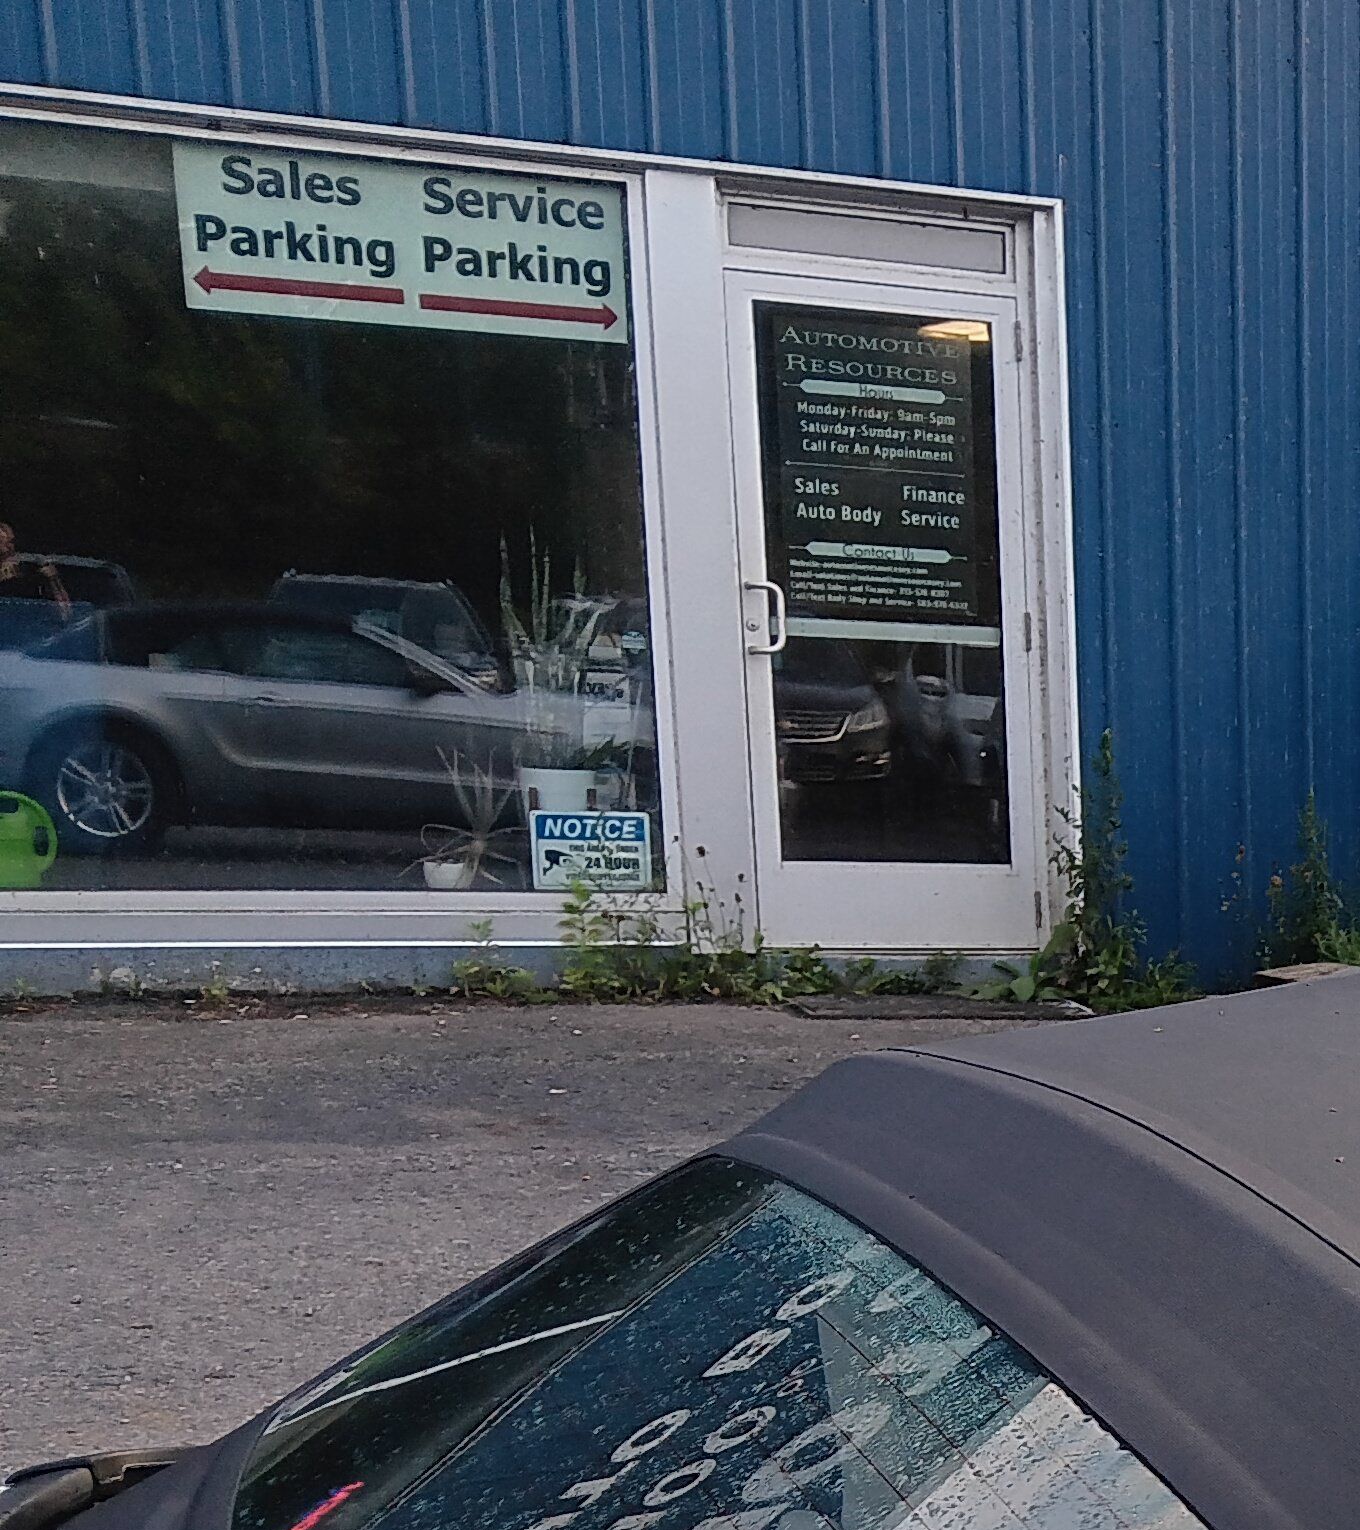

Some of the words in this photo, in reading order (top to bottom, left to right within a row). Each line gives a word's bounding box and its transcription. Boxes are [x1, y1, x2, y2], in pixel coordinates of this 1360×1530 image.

[221, 155, 362, 206] Sales
[422, 176, 605, 230] Service
[193, 214, 396, 278] Parking
[422, 235, 611, 297] Parking
[779, 325, 959, 359] AUTOMOTIVE
[784, 353, 958, 385] RESOURCES
[858, 383, 894, 400] Hours
[897, 408, 956, 427] 9am-5pm
[914, 428, 955, 445] Please
[802, 438, 827, 452] Call
[830, 440, 850, 454] For
[853, 442, 870, 455] An
[873, 444, 954, 463] Appointment
[794, 477, 840, 496] Sales
[902, 485, 966, 505] Finance
[796, 502, 836, 520] Auto
[841, 504, 882, 527] Body
[901, 509, 960, 529] Service
[842, 543, 897, 560] Contact
[584, 856, 602, 869] 24
